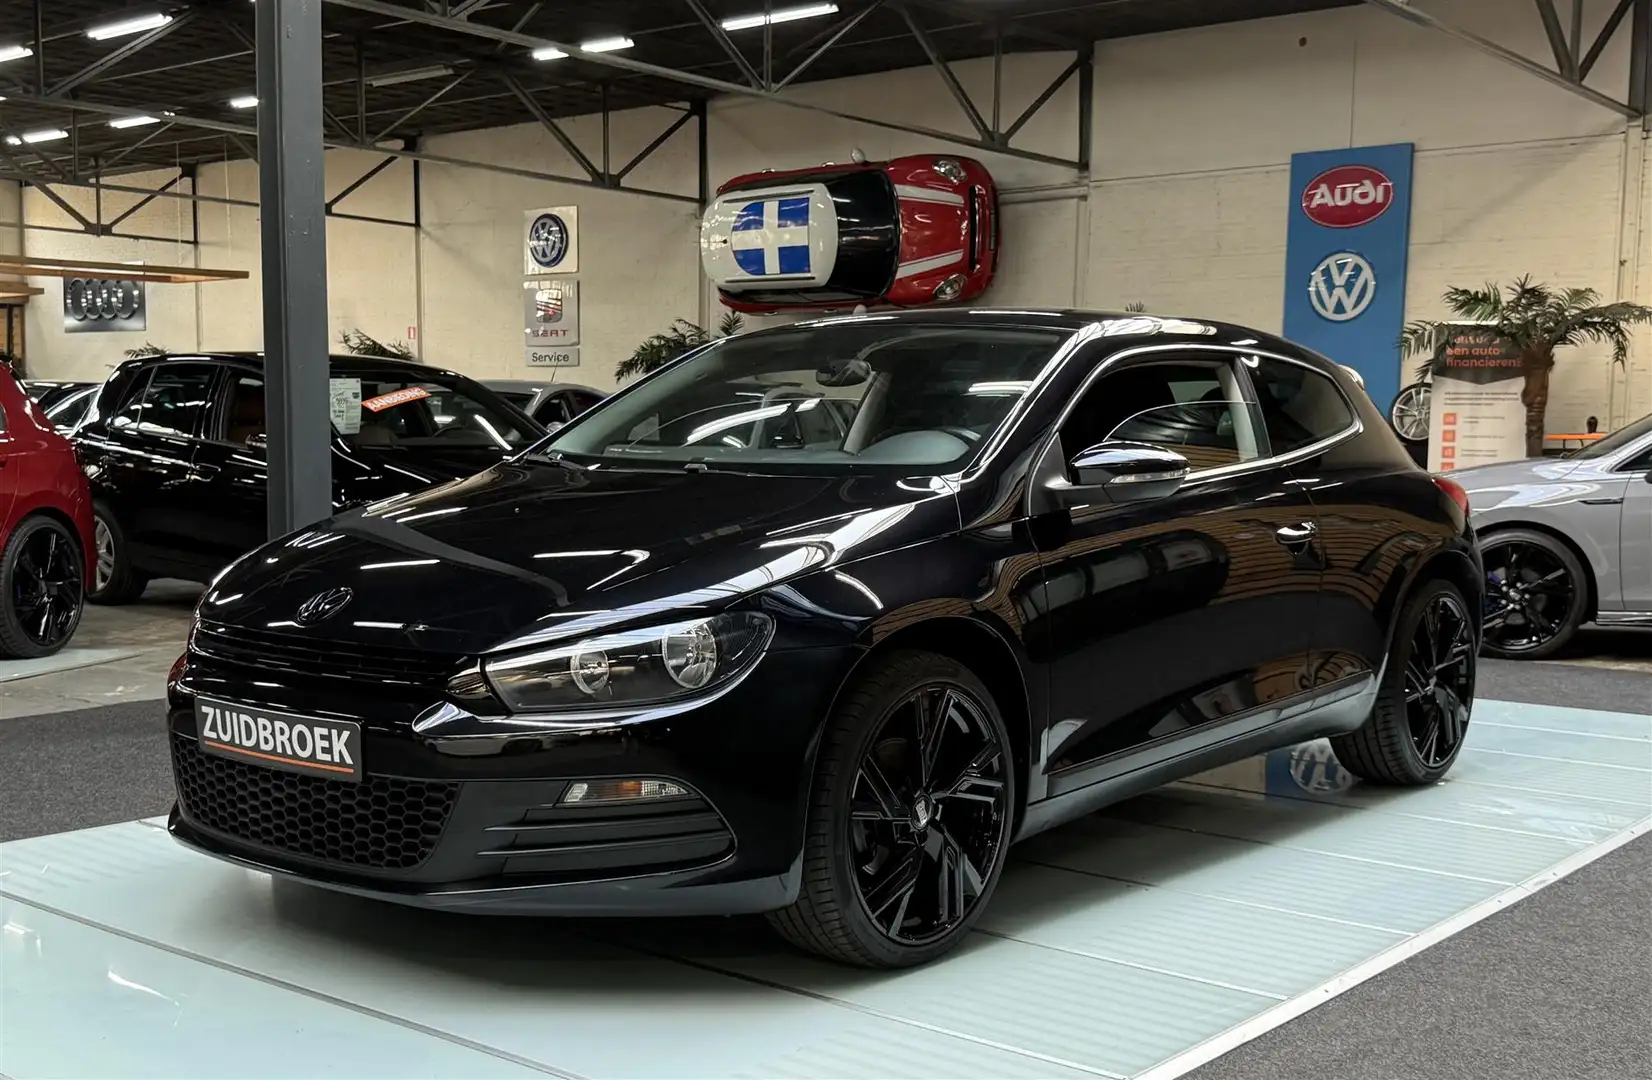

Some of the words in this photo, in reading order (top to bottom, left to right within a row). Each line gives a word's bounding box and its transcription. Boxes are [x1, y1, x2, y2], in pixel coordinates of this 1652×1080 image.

[1309, 180, 1385, 208] Audi
[1310, 252, 1375, 320] VW
[532, 329, 569, 338] SEAT
[531, 352, 570, 363] Service
[1471, 345, 1501, 356] auto
[201, 705, 354, 765] ZUIDBROEK
